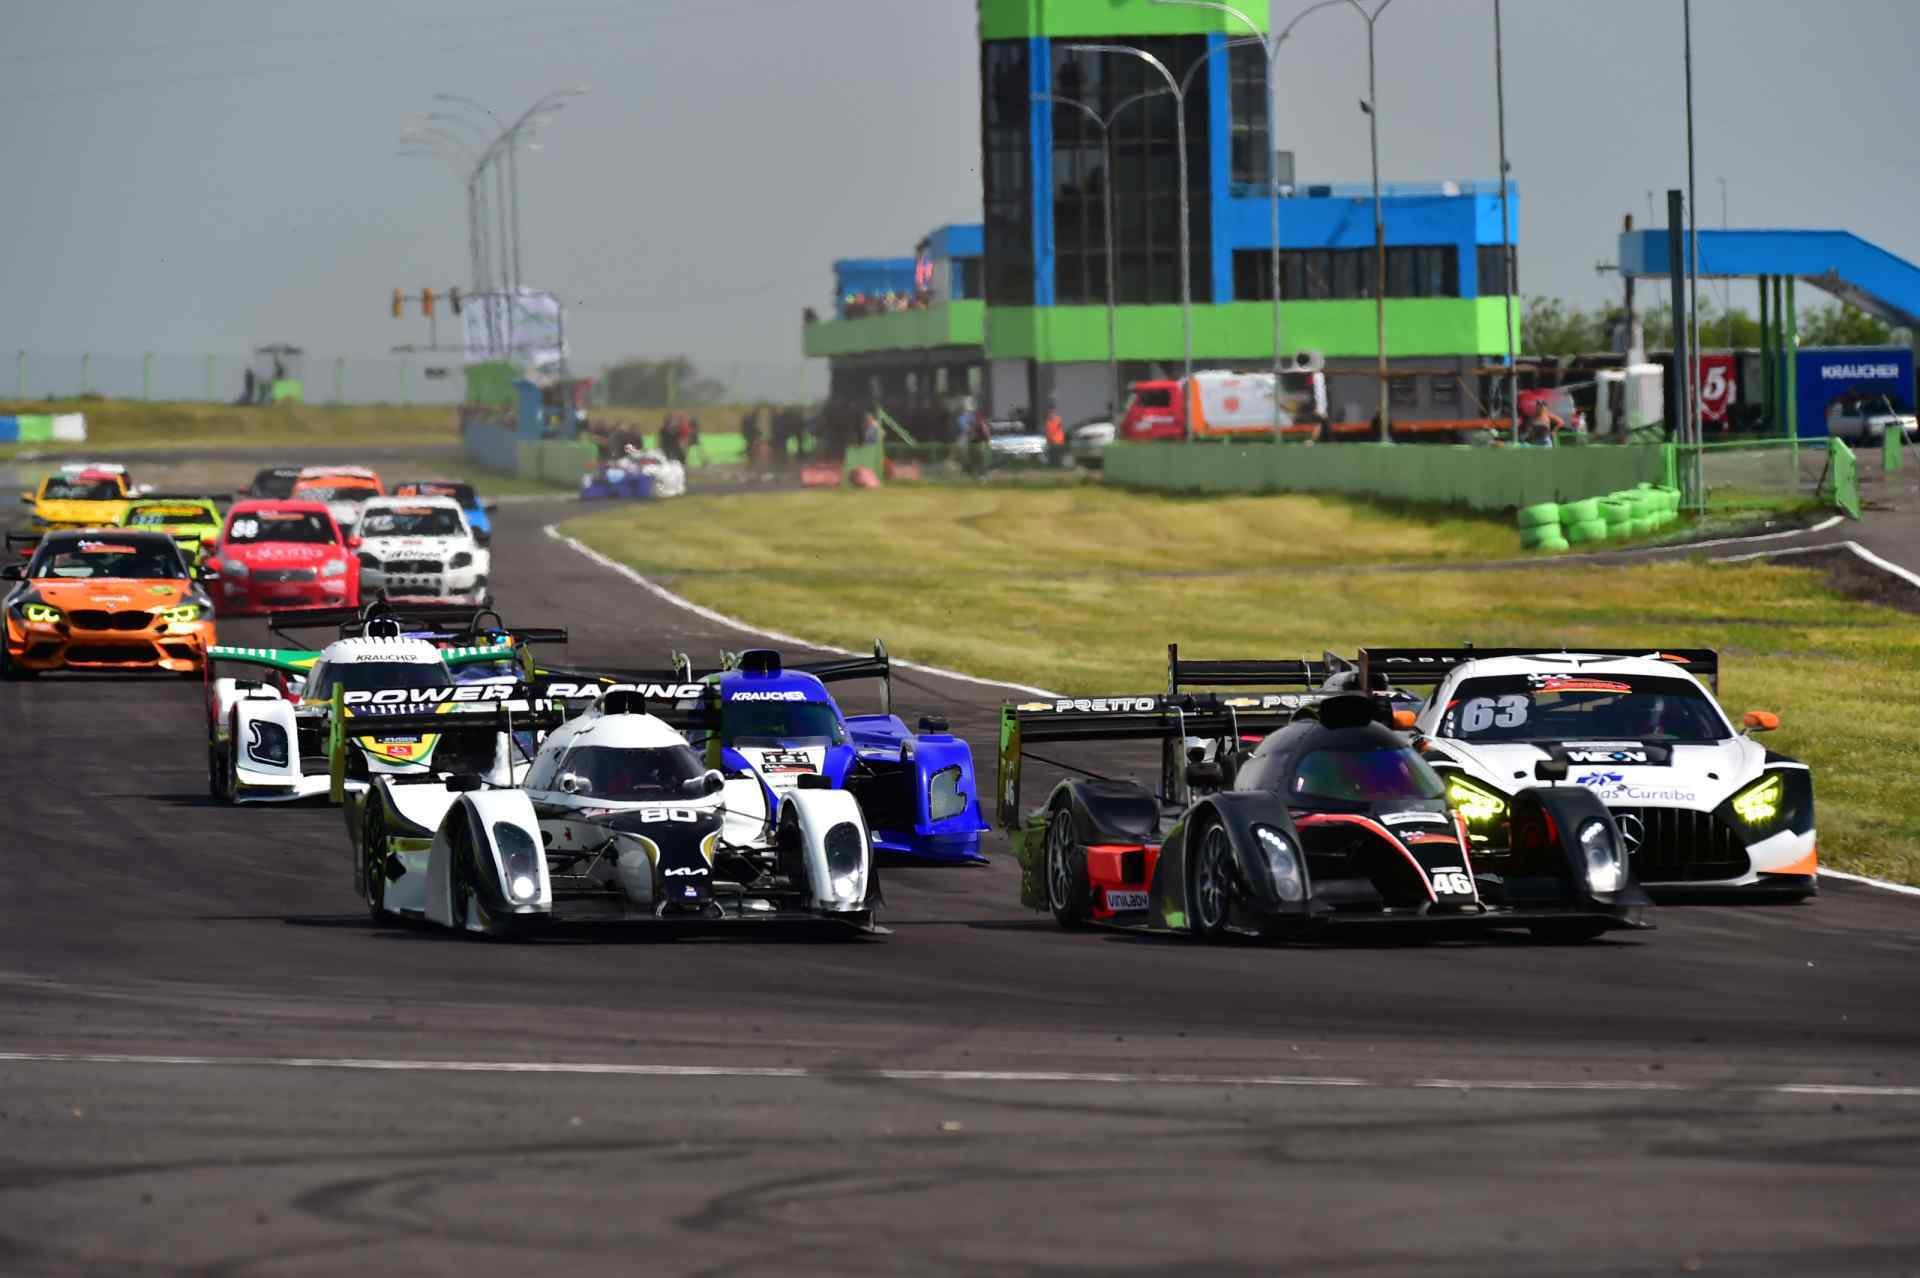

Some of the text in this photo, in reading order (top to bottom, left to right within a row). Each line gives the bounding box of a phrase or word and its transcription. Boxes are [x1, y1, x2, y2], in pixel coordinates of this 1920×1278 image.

[1821, 363, 1900, 379] KRAUCHER
[1703, 366, 1727, 400] 5
[356, 653, 418, 662] KRAUCHER
[343, 685, 514, 704] POWER
[731, 691, 807, 701] KRAUCHER
[1056, 697, 1155, 713] PRETTO
[1461, 695, 1528, 732] 63
[1626, 787, 1696, 801] Curitiba
[640, 808, 697, 823] 80
[1432, 873, 1473, 894] 46
